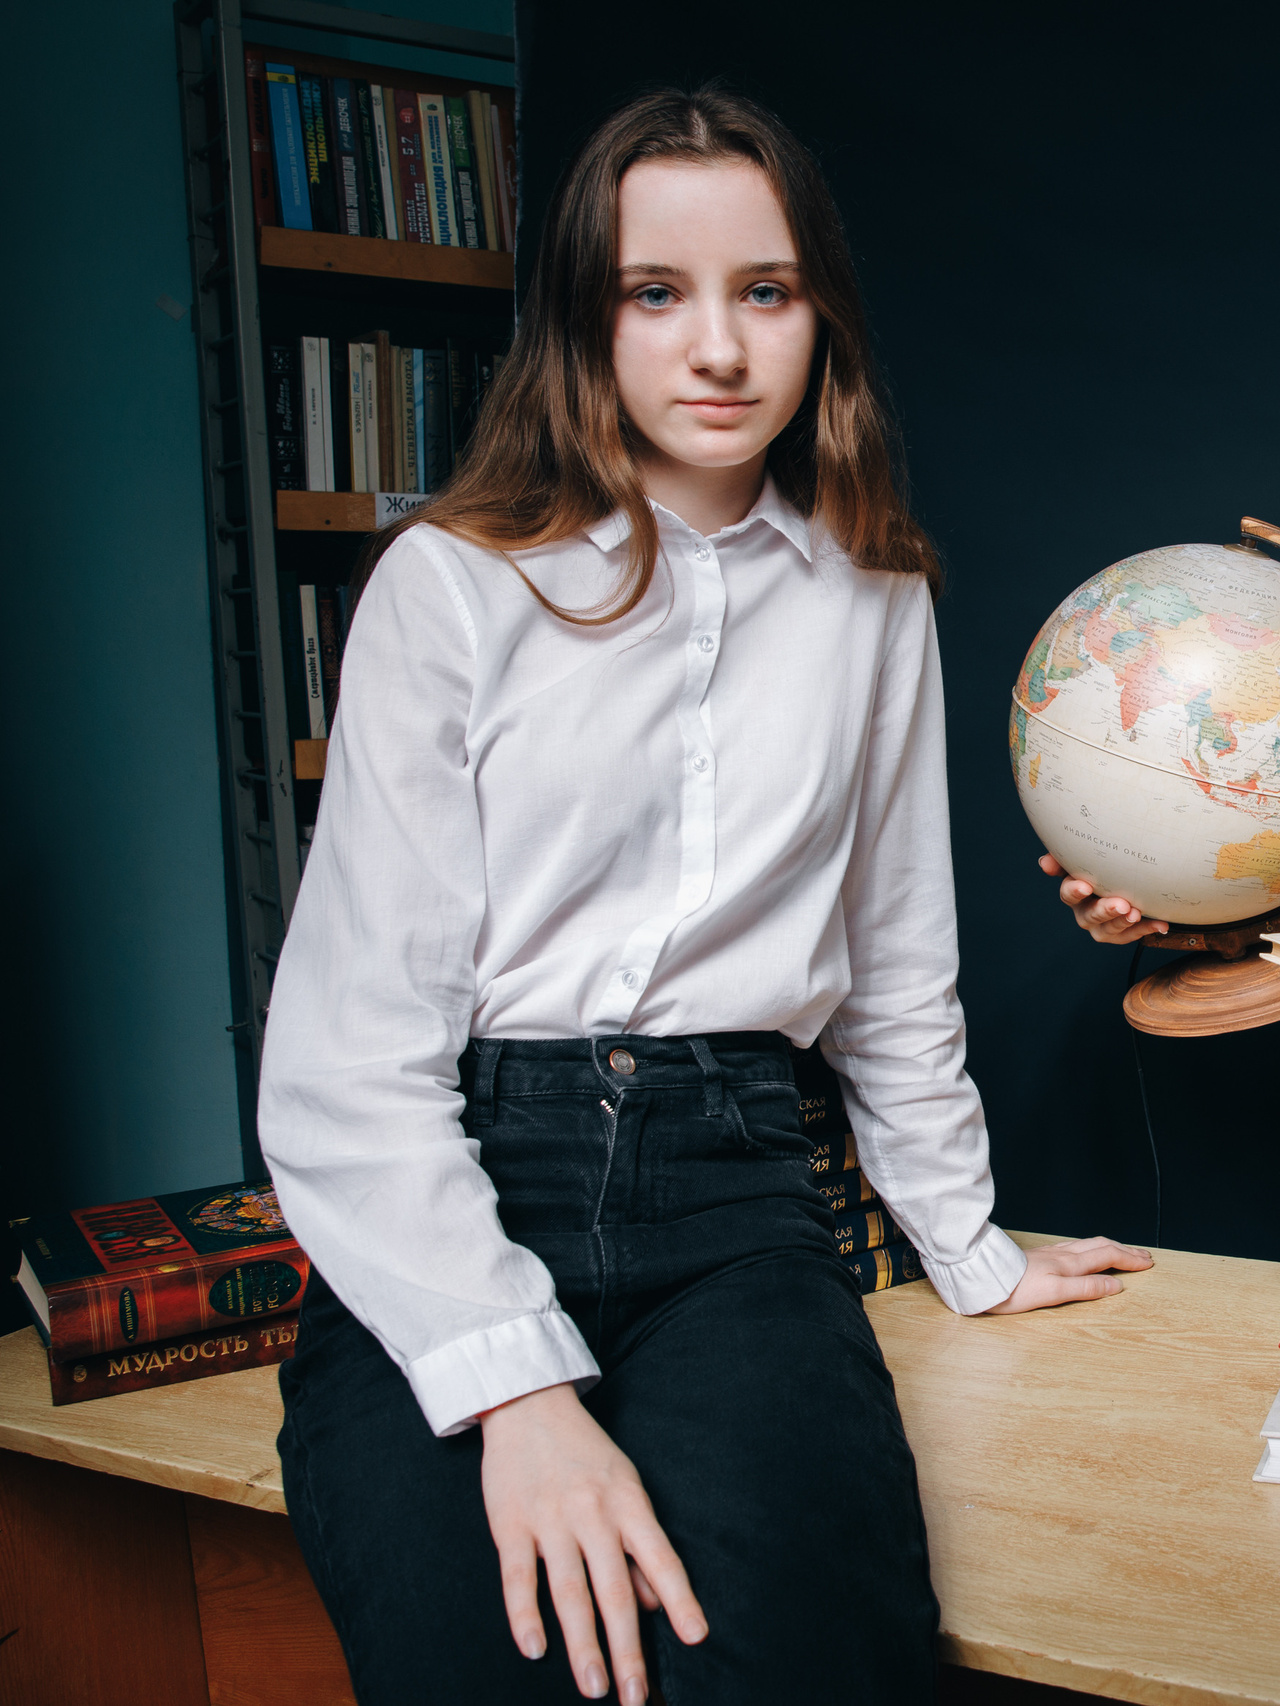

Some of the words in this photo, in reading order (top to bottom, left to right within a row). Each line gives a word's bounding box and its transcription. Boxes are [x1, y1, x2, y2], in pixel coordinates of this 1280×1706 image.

[301, 79, 321, 185] ЭНЦИКЛОПЕДИЯ
[336, 96, 352, 133] ДЕВОЧЕК
[451, 114, 469, 150] ДЕВОЧЕК
[342, 156, 359, 209] ЭНЦИКЛОПЕДИЯ
[346, 208, 361, 237] МЕННАЯ
[406, 199, 418, 234] ПОЛНАЯ
[404, 360, 414, 403] ВЫСОТА
[1165, 564, 1215, 585] РОССИЙСКАЯ
[1227, 584, 1278, 602] ФЕДЕРАЦИЯ
[1224, 627, 1257, 640] МОНГОЛИЯ
[1063, 824, 1119, 852] ИНДИЙСКИЙ
[1123, 847, 1156, 863] ОКЕАН
[123, 1290, 134, 1331] ИШИМОВА
[107, 1334, 250, 1379] МУДРОСТЬ
